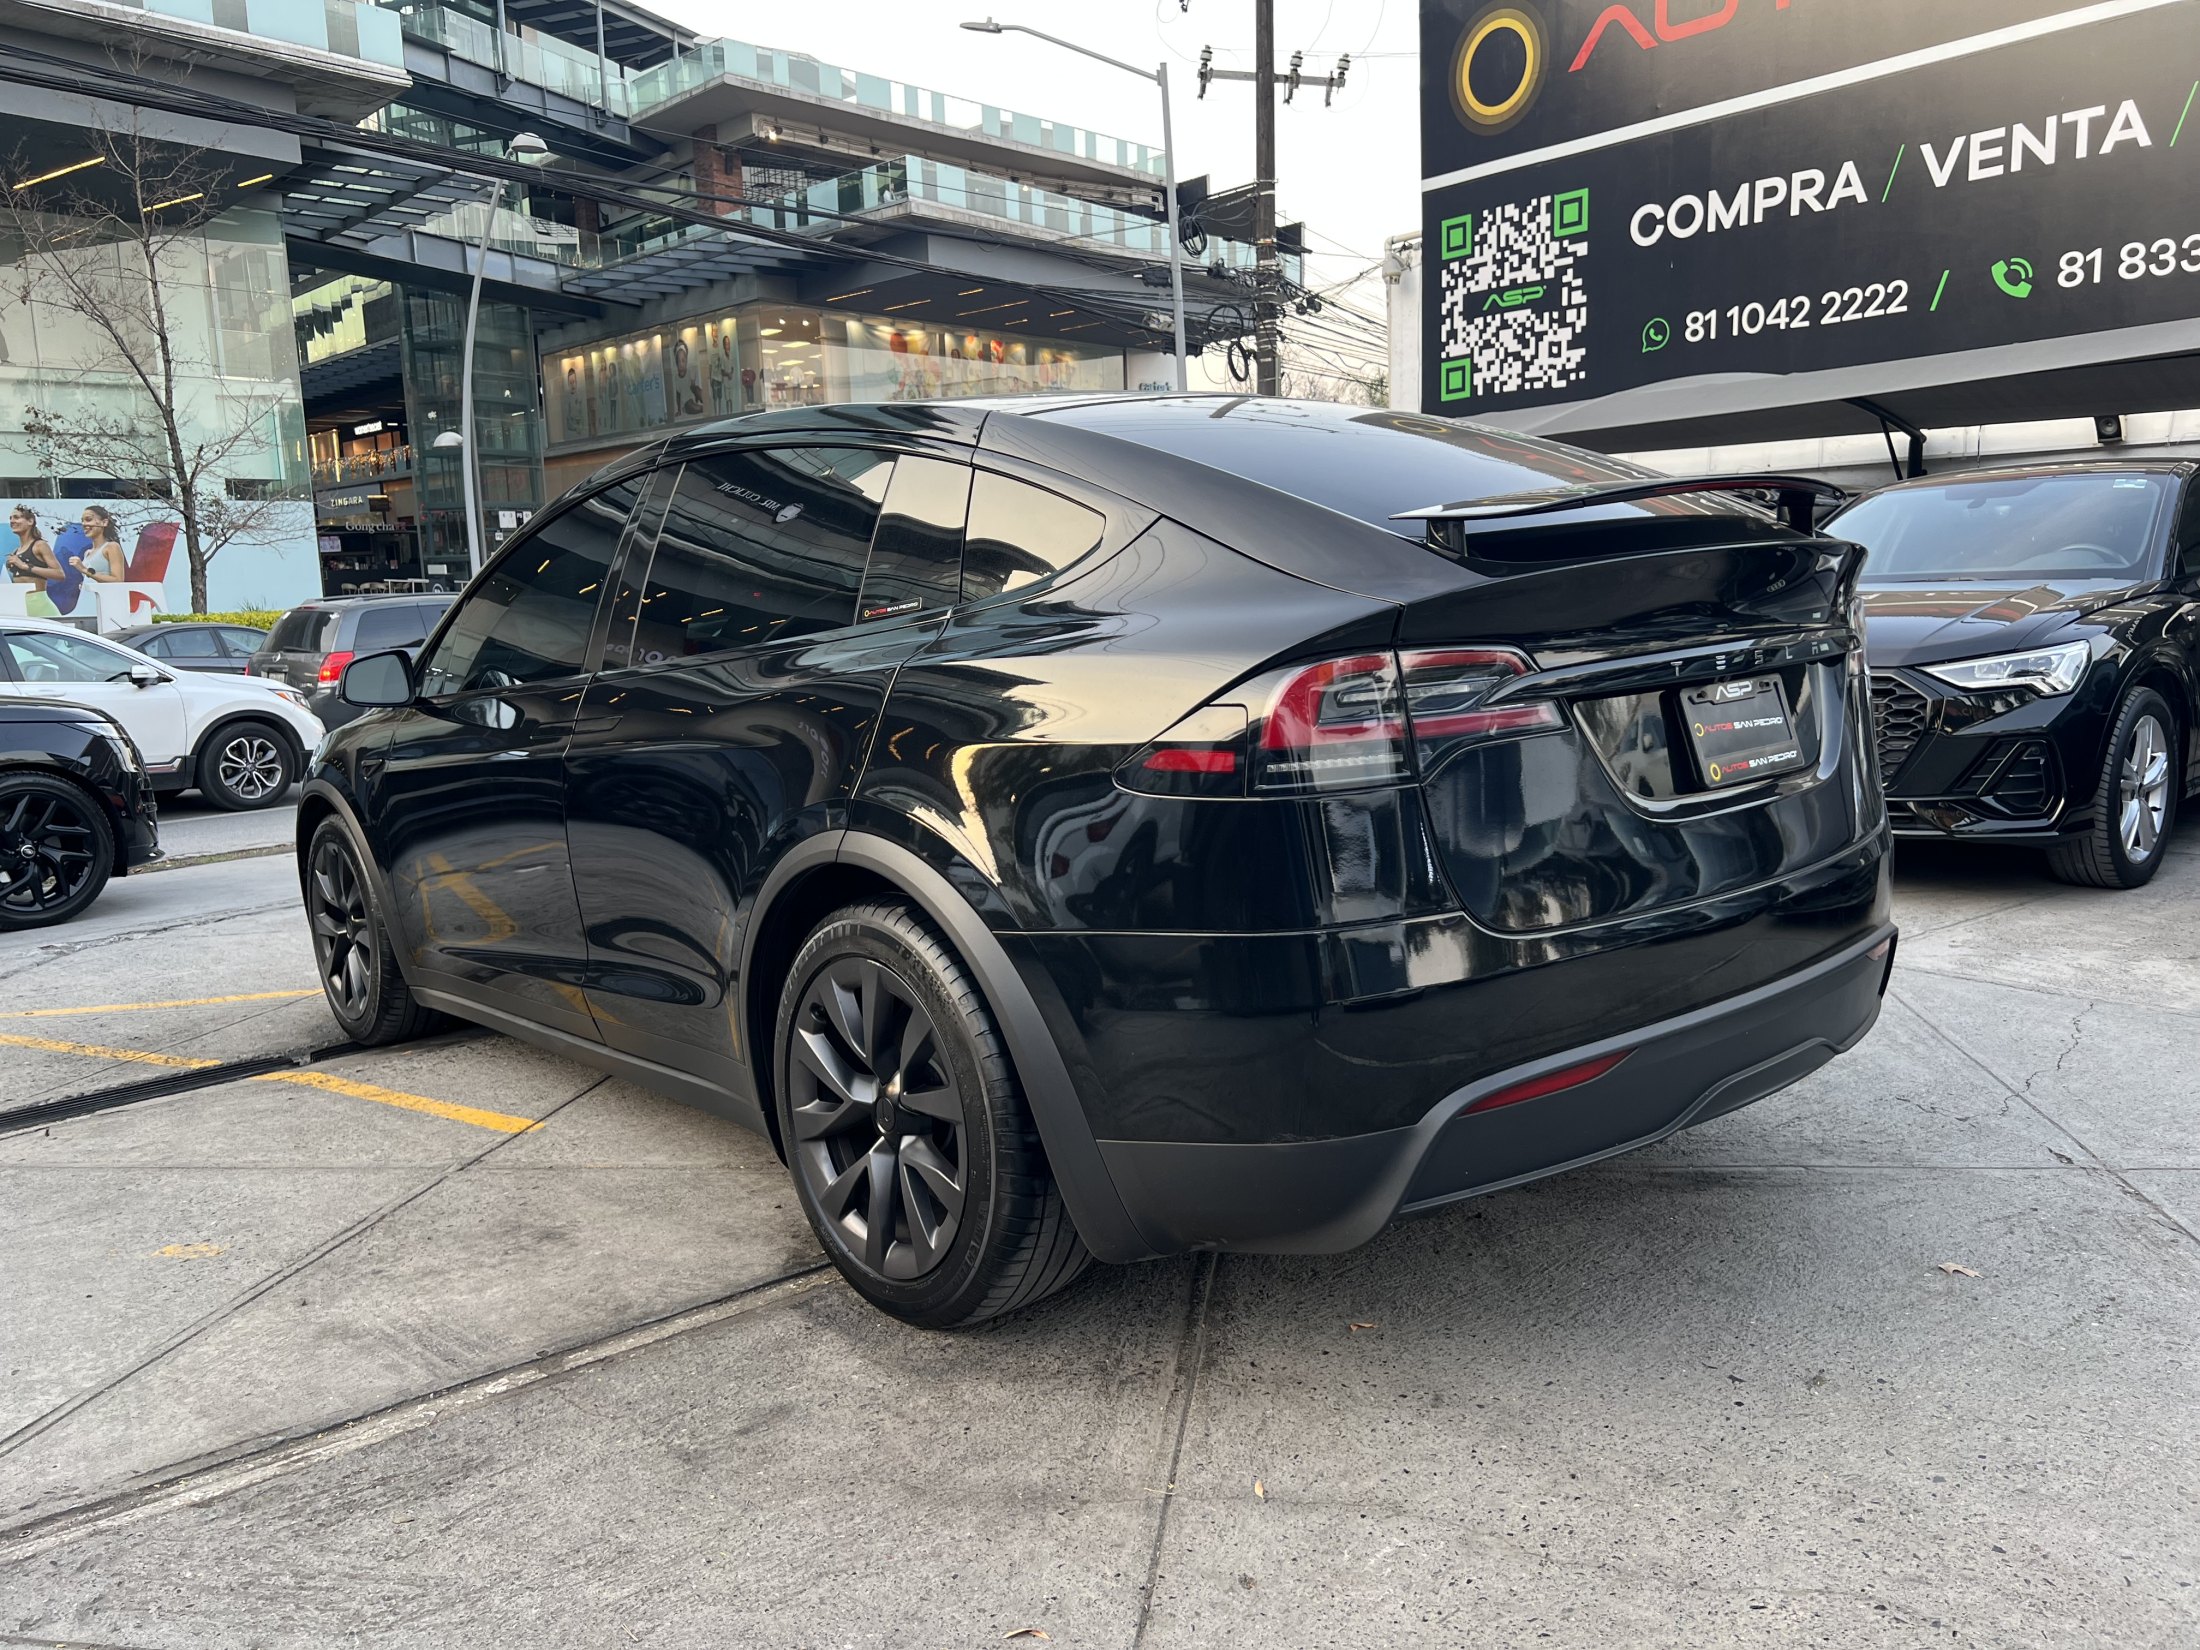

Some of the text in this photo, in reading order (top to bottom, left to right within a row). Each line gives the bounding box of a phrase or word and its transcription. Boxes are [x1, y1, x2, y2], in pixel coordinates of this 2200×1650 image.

[1629, 160, 1869, 247] COMPRA
[1919, 98, 2153, 188] VENTA
[2057, 247, 2103, 288] 81
[1482, 285, 1544, 311] ASP
[1684, 308, 1717, 343] 81
[1726, 295, 1811, 337] 1042
[1820, 279, 1909, 326] 2222
[331, 495, 364, 507] ZINGARA
[345, 521, 375, 534] Gong
[376, 521, 395, 531] cha
[1716, 680, 1753, 700] ASP
[1704, 716, 1784, 733] AUTOS SAN PEDRO
[1721, 750, 1798, 774] AUTOS SAN PEDRO
